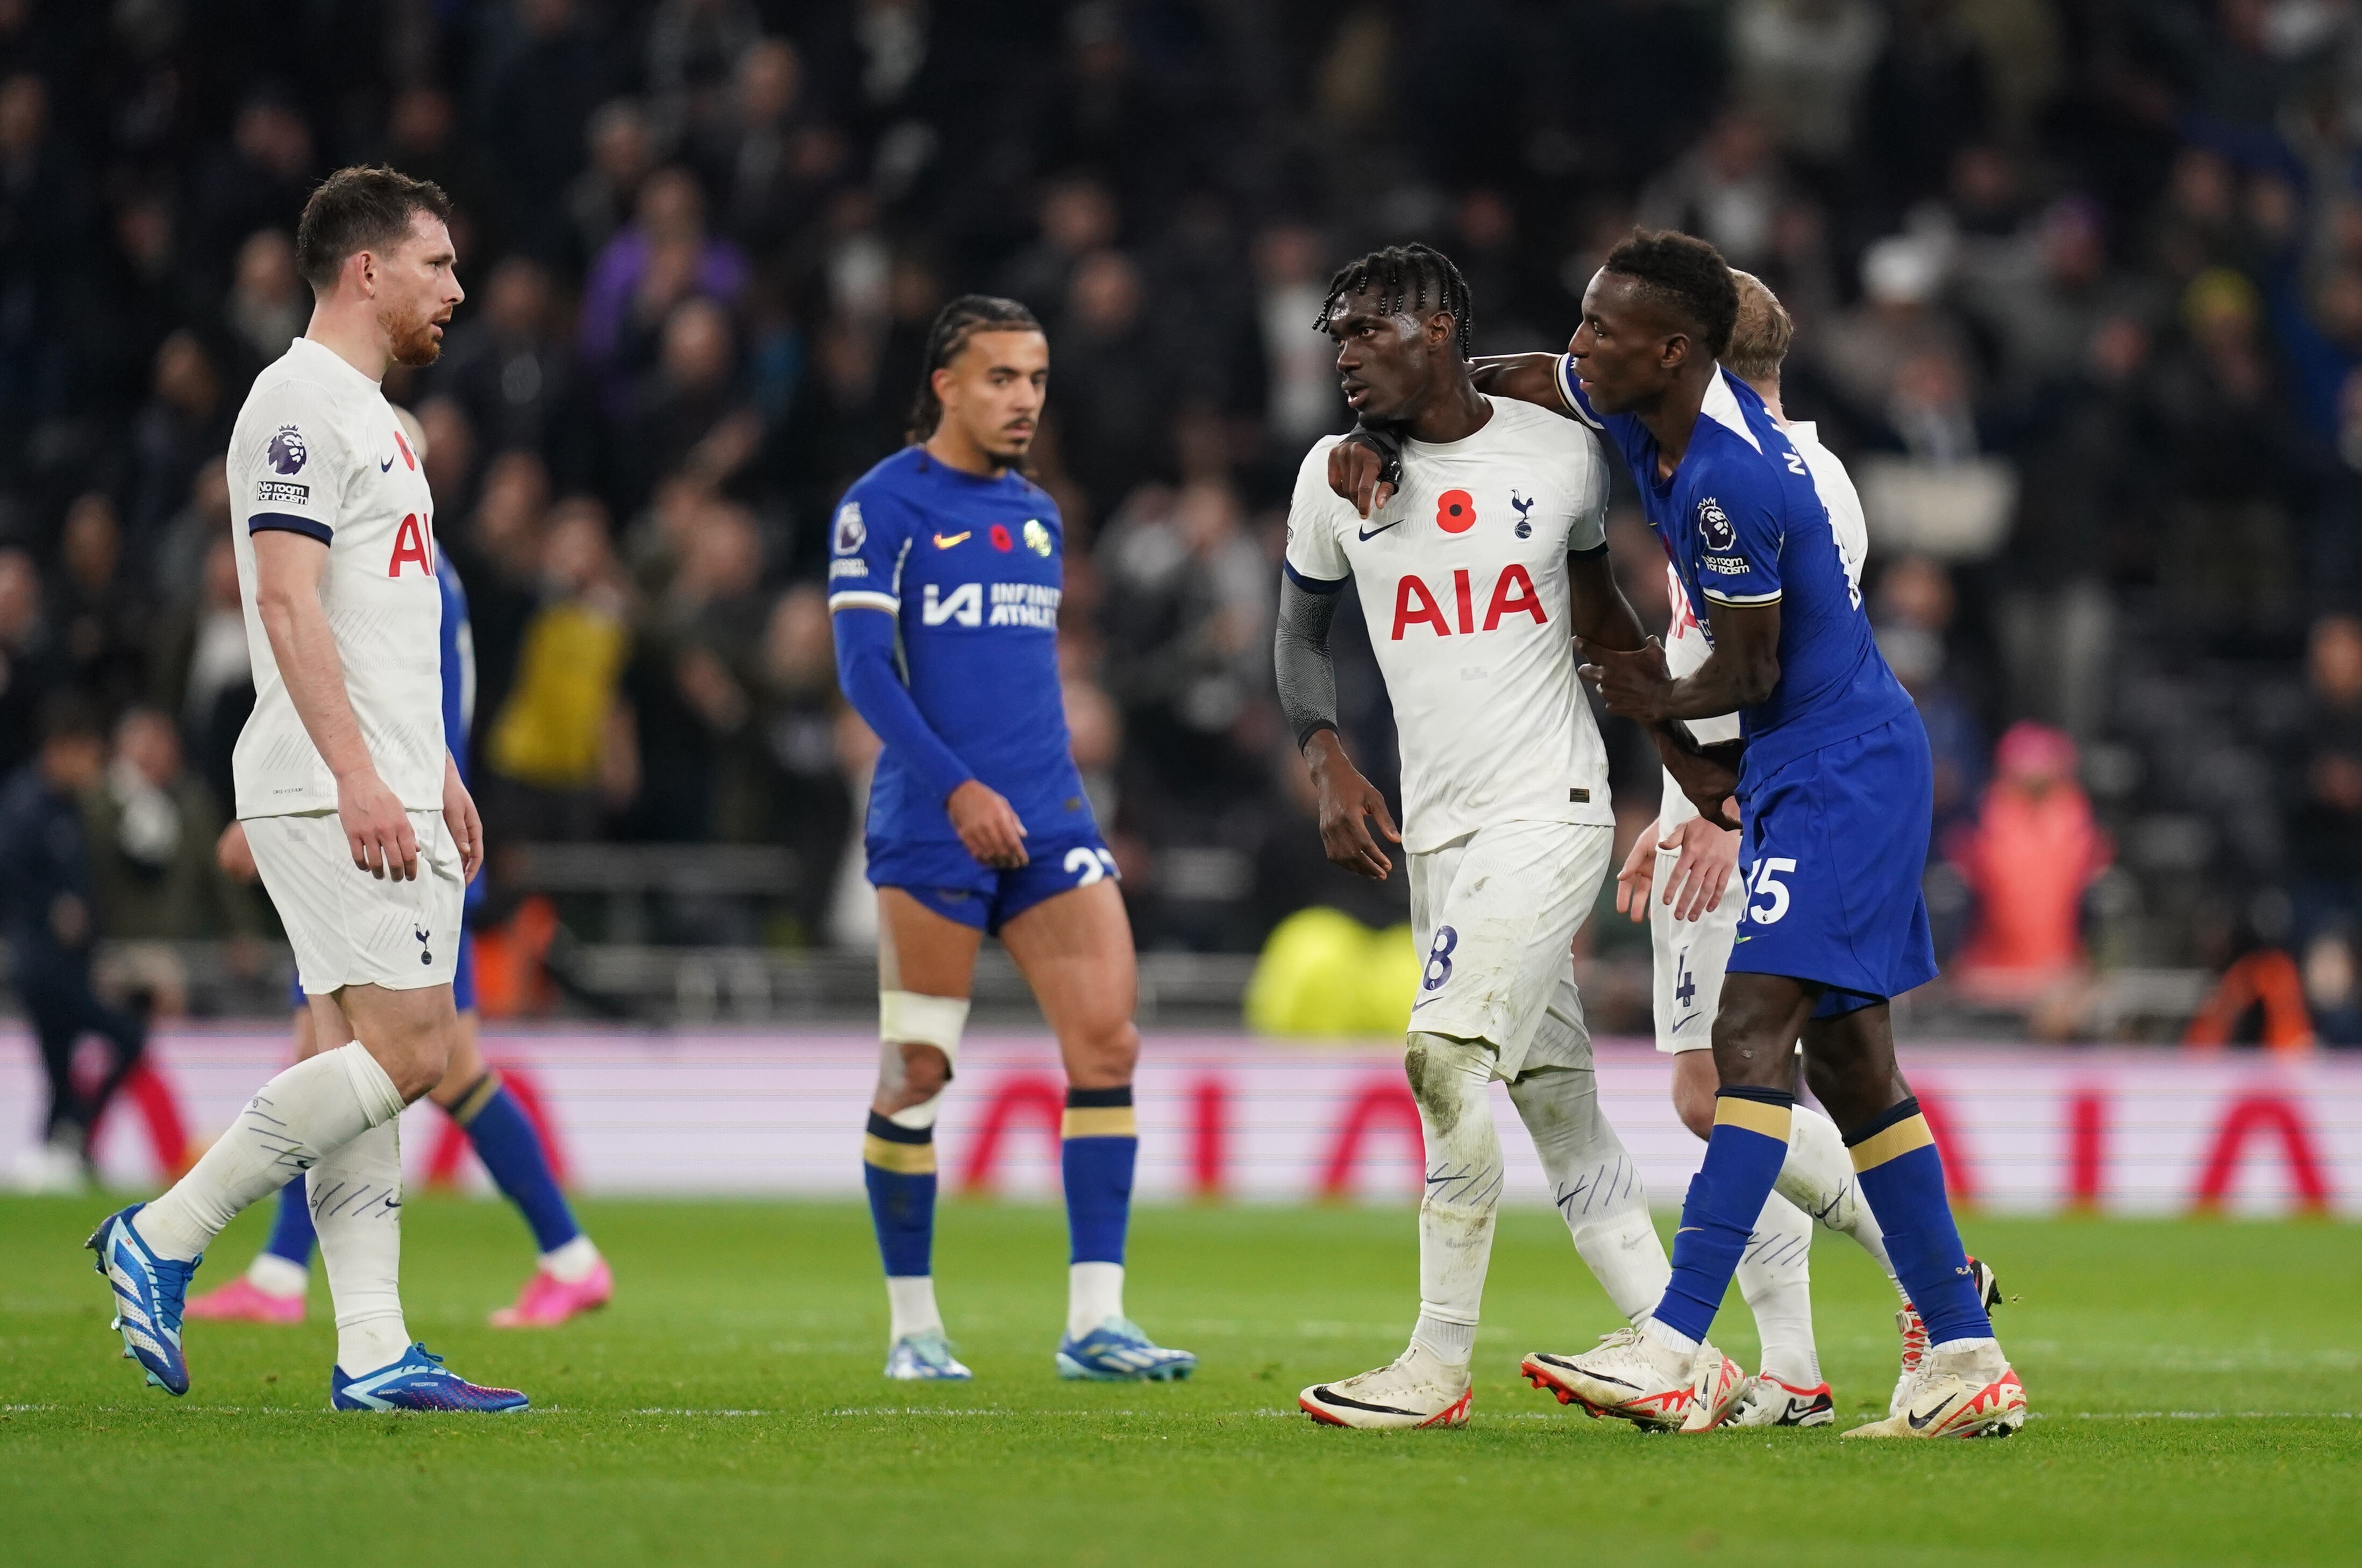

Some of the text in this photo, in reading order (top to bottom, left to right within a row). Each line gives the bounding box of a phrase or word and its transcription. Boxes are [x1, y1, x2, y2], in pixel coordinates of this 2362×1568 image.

[258, 482, 304, 496] No room
[257, 490, 308, 505] for racism
[1702, 555, 1744, 567] No room
[1706, 562, 1751, 575] for racism
[1391, 564, 1548, 640] AIA
[1423, 925, 1458, 991] 8
[1675, 945, 1696, 1008] 4
